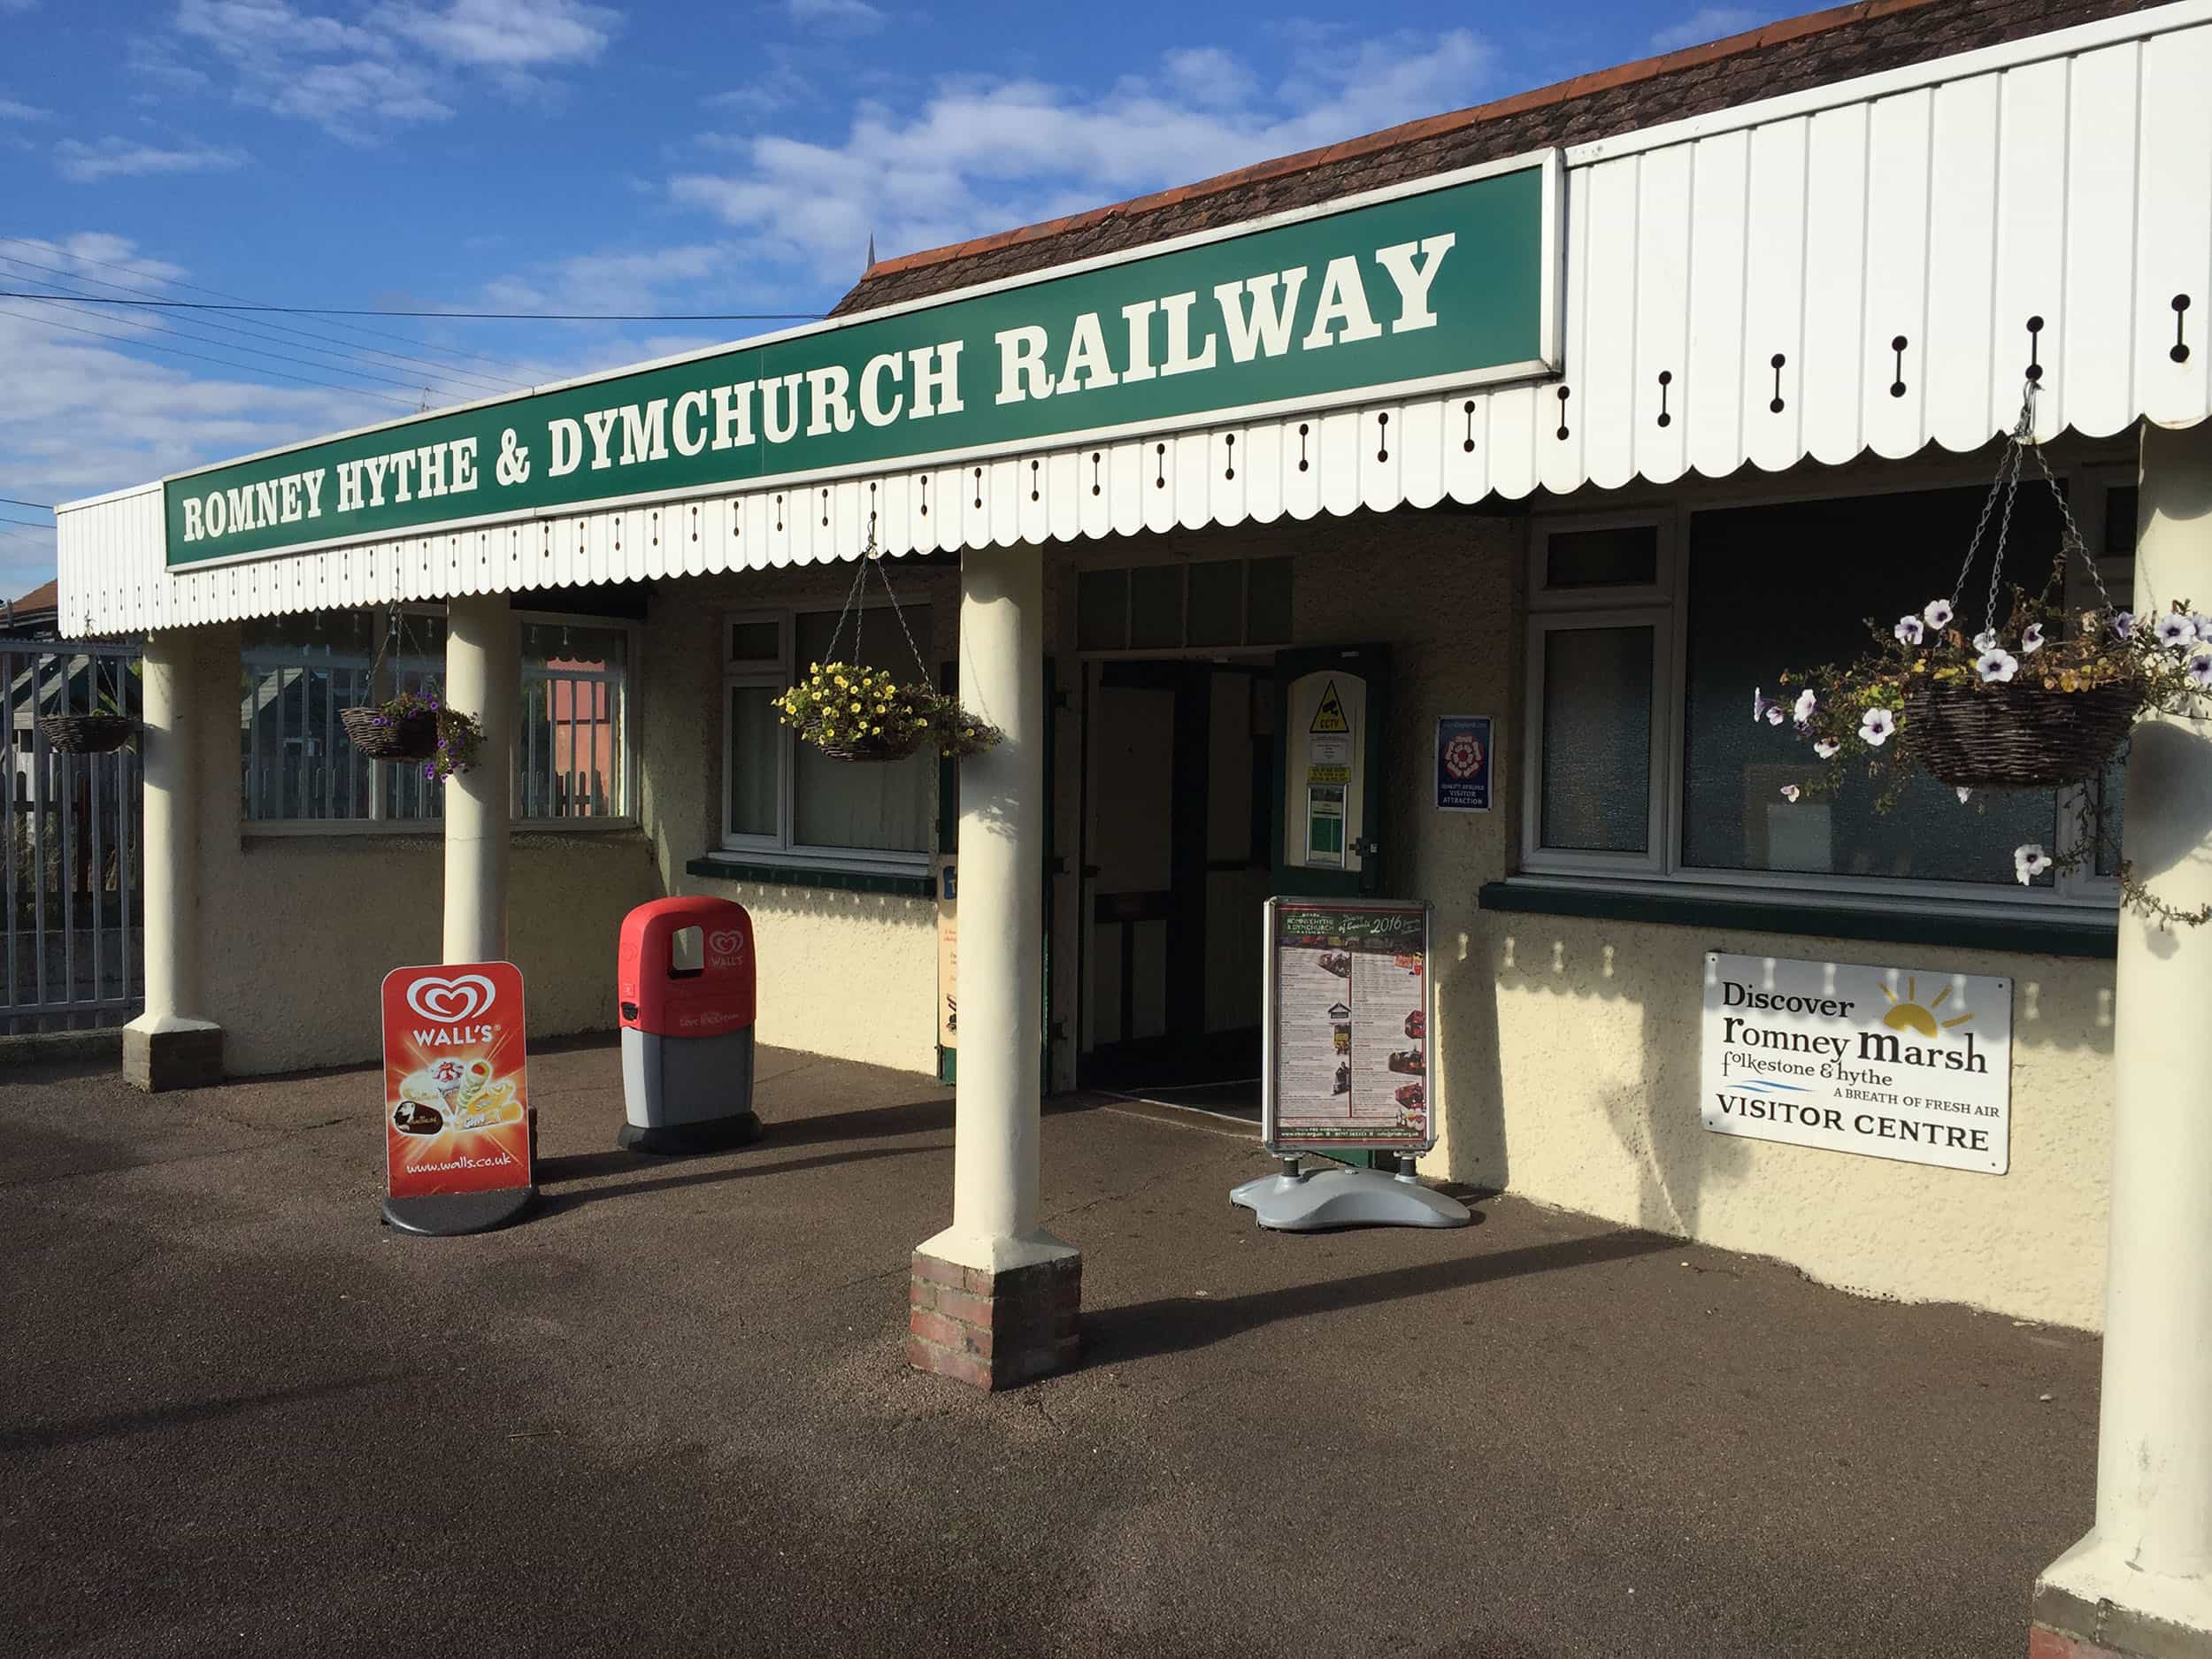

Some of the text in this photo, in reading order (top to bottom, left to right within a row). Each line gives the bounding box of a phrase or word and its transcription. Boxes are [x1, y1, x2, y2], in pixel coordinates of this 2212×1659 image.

[183, 232, 1455, 541] ROMNEY HYTHE & DYMCHURCH RAILWAY
[1442, 796, 1484, 805] ATTRACTION
[1371, 914, 1402, 933] 2016
[1722, 981, 1855, 1018] Discover
[412, 1025, 493, 1048] WALL'S
[1723, 1016, 1989, 1074] romney marsh
[1721, 1050, 1893, 1087] folkestone & hythe
[1833, 1087, 2001, 1118] A BREATH OF FRESH AIR
[1716, 1093, 1989, 1152] VISITOR CENTRE
[406, 1152, 511, 1174] www.walls.co.uk
